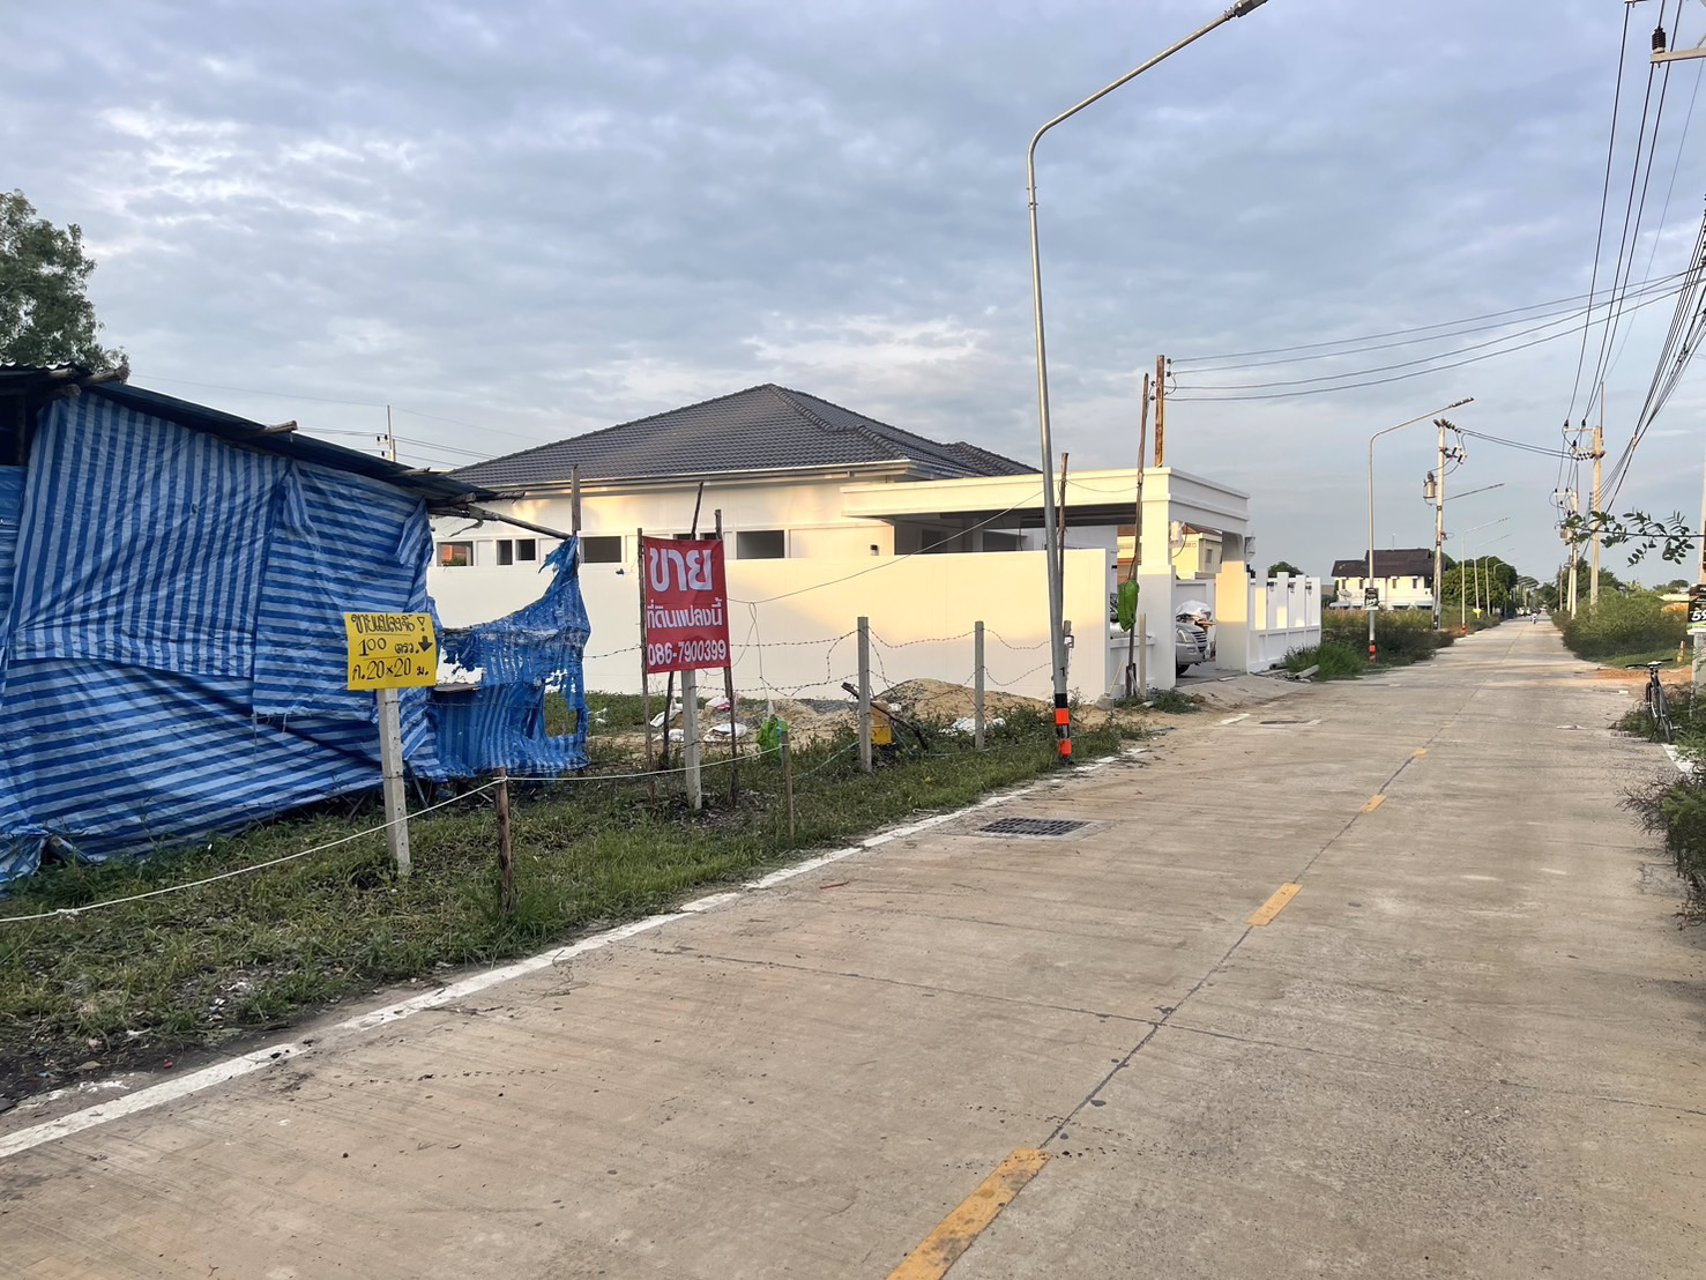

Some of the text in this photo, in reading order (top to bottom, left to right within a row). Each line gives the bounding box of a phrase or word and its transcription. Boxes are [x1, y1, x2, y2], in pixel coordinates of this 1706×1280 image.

[650, 547, 713, 592] ขาย
[647, 598, 723, 629] ที่ดินแปลงนี้
[358, 637, 386, 656] 100
[648, 640, 725, 666] 086-7900399
